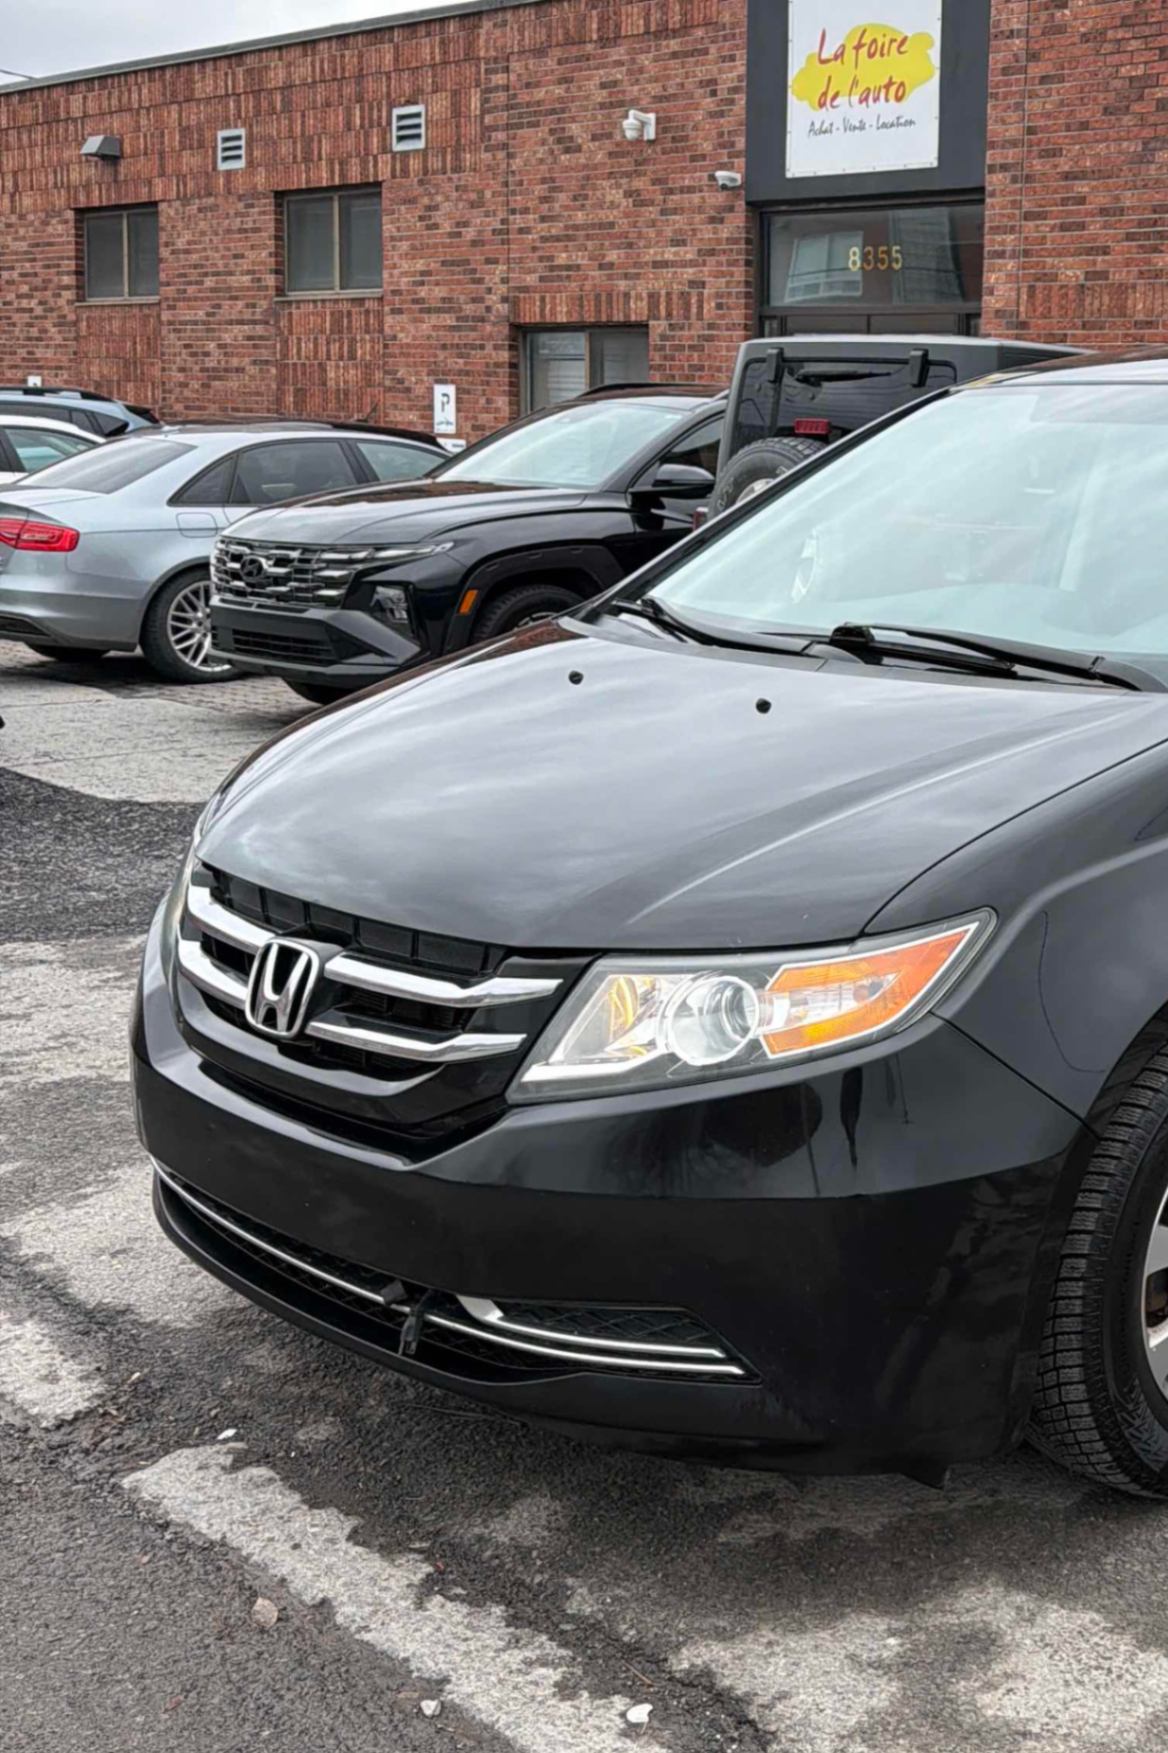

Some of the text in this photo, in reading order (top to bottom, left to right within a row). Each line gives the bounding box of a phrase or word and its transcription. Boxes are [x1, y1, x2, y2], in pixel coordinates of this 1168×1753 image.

[818, 27, 909, 70] La foire
[818, 74, 906, 112] de l'auto
[808, 119, 834, 137] Achat
[843, 116, 867, 133] Vente
[876, 114, 916, 131] Location
[848, 246, 903, 272] 8355
